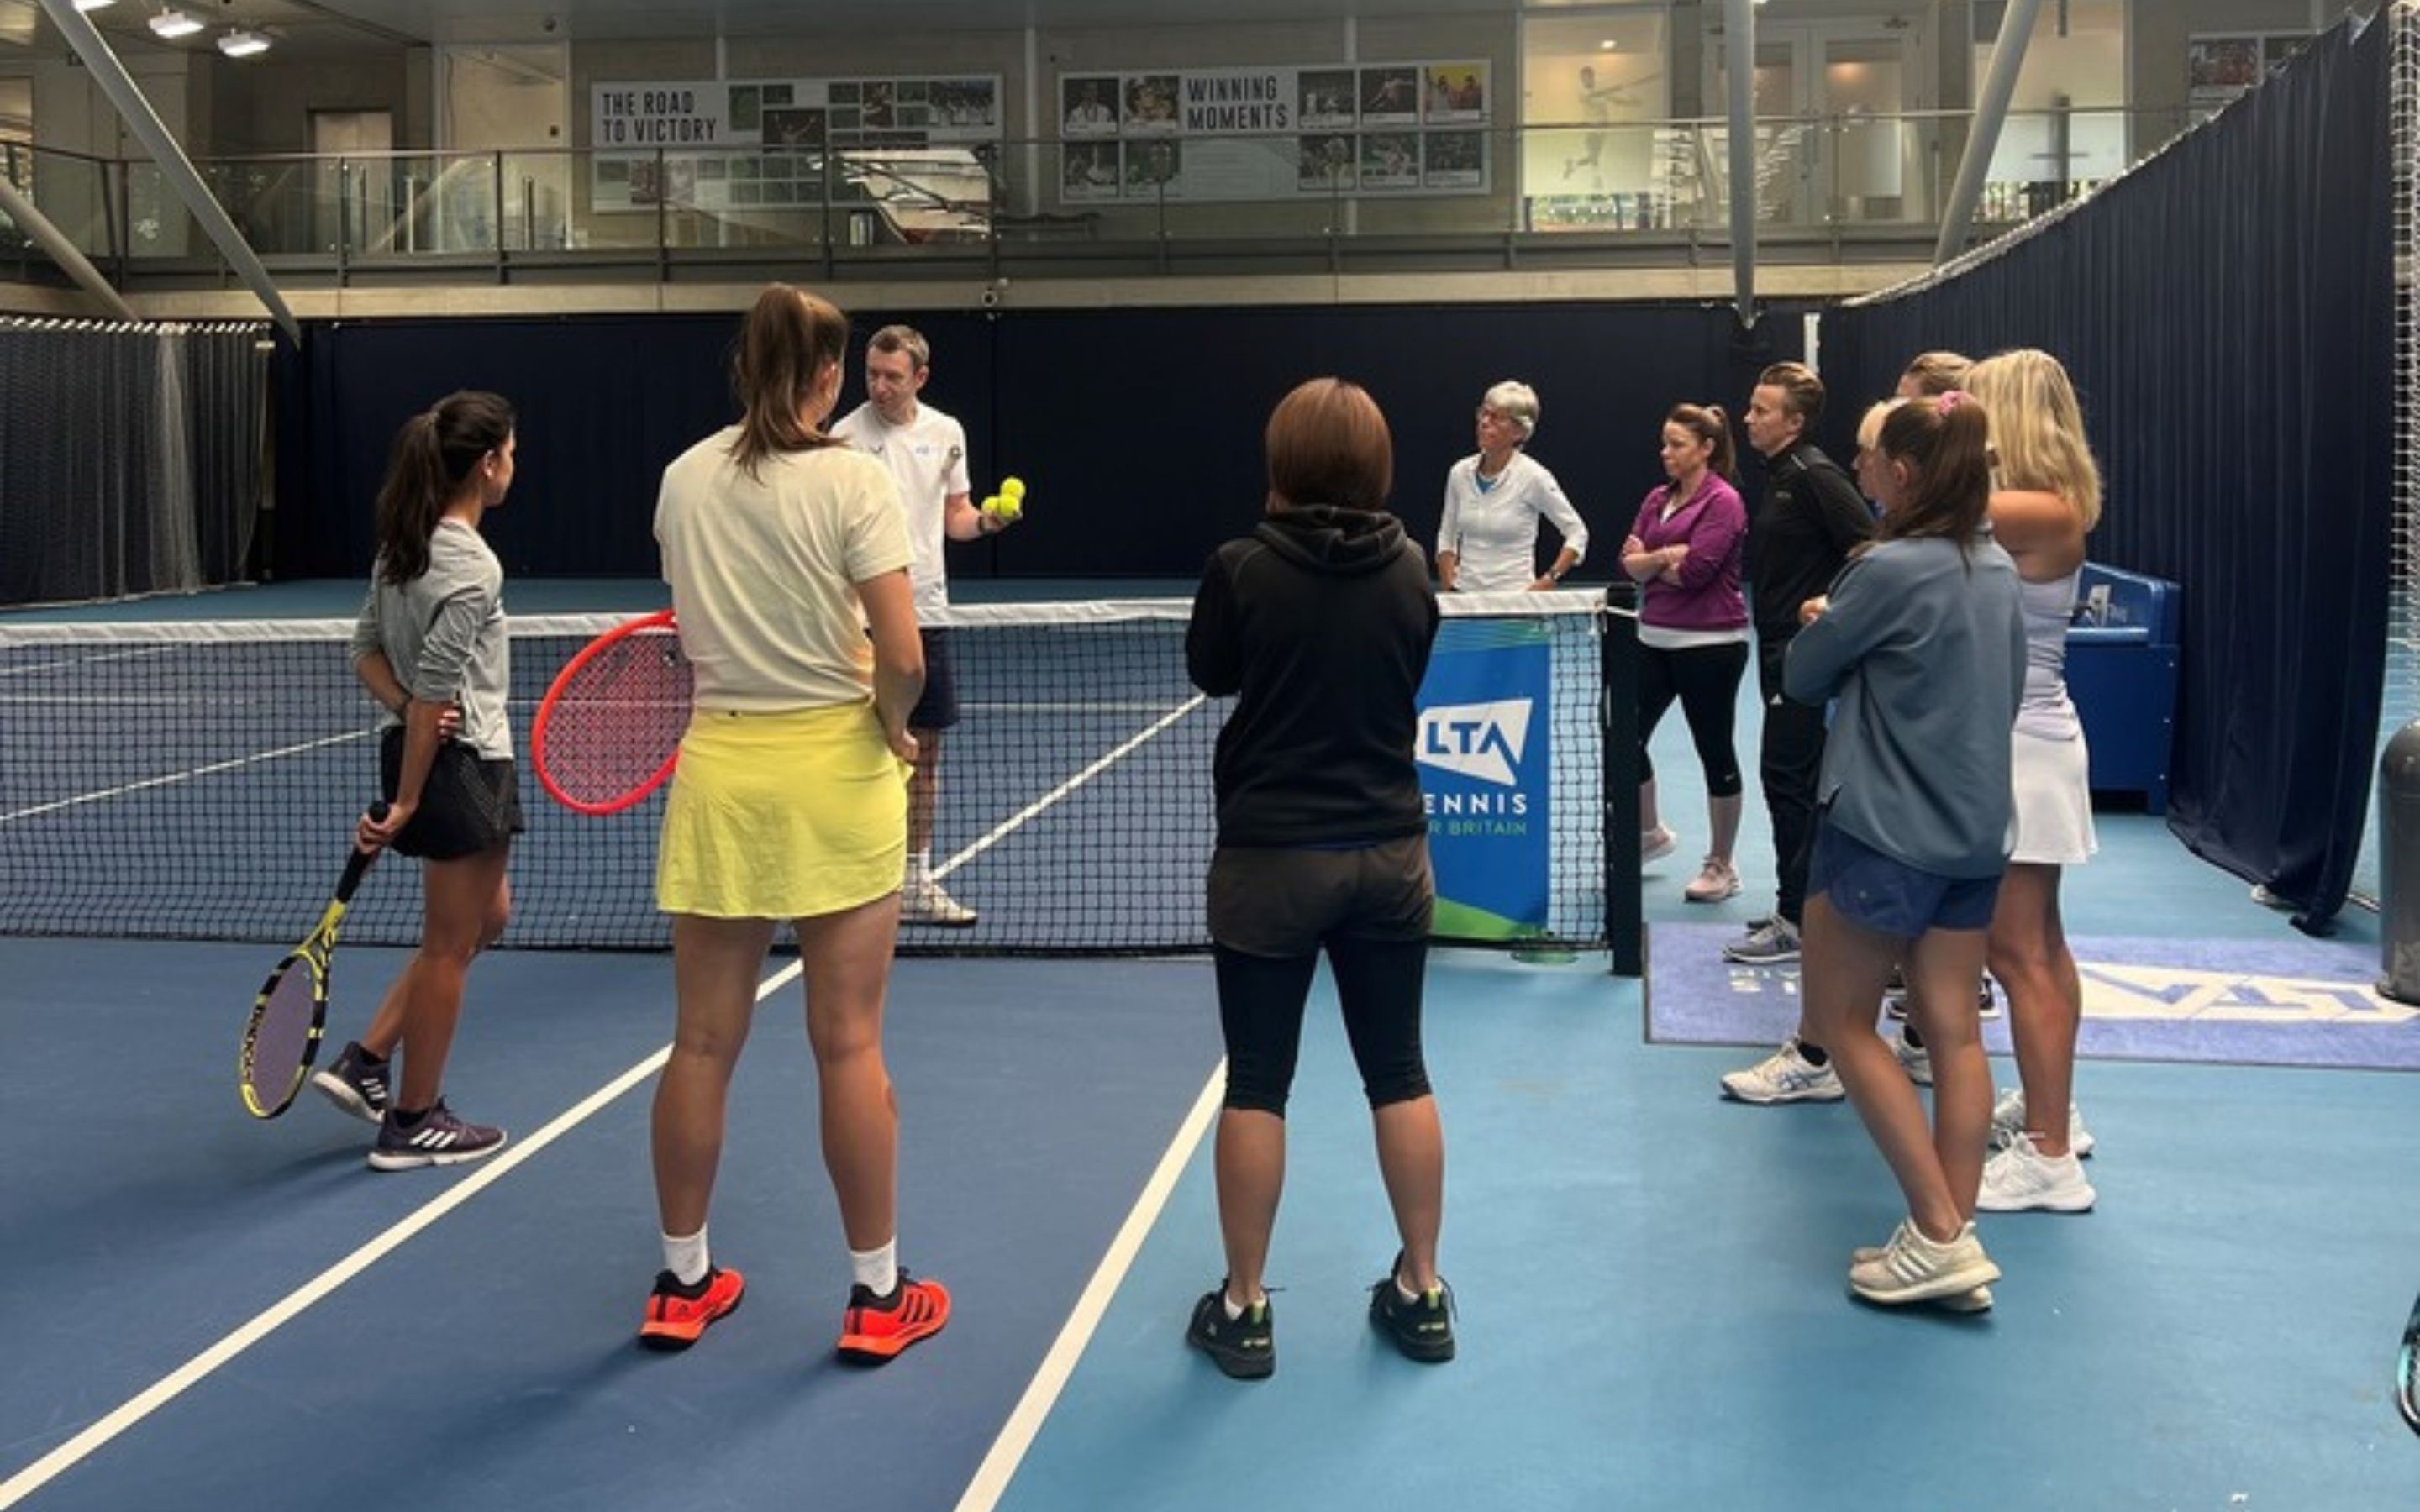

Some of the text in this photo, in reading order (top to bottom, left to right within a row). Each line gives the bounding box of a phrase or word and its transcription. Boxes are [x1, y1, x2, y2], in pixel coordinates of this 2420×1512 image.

[1187, 75, 1276, 102] WINNING
[602, 90, 694, 116] THE ROAD
[1187, 103, 1287, 129] MOMENTS
[602, 117, 716, 142] TO VICTORY
[1426, 721, 1518, 771] LTA
[1422, 793, 1528, 815] ENNIS
[1448, 818, 1527, 836] BRITAIN
